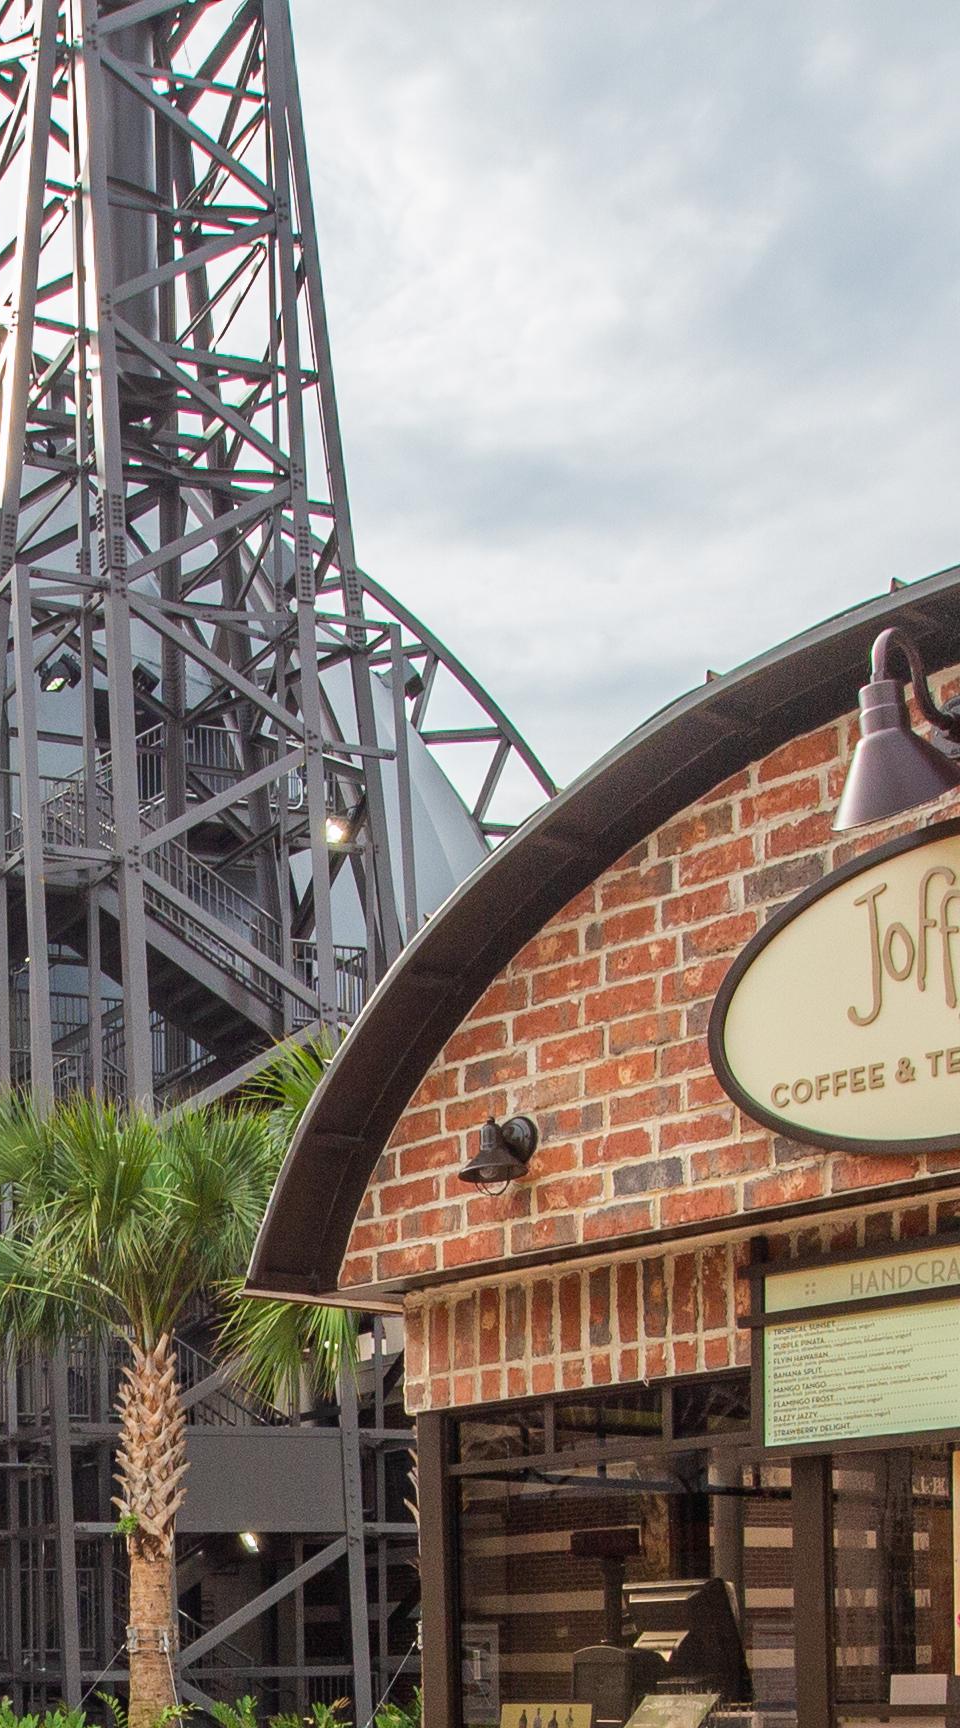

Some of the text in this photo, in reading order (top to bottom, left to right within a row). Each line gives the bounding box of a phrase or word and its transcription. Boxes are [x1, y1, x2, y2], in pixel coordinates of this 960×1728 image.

[771, 1062, 885, 1108] COFFEE
[895, 1056, 916, 1083] &
[773, 1340, 798, 1350] PURPLE
[773, 1369, 801, 1379] BANANA
[803, 1366, 821, 1375] SPLIT
[773, 1384, 799, 1394] MANGO
[802, 1380, 826, 1390] TANGO
[773, 1397, 810, 1409] FLAMINGO
[811, 1394, 833, 1403] FROST
[773, 1414, 796, 1423] RAZZY
[797, 1411, 817, 1419] JAZZY
[773, 1425, 818, 1438] STRAWBERRY
[820, 1421, 850, 1432] DELIGHT
